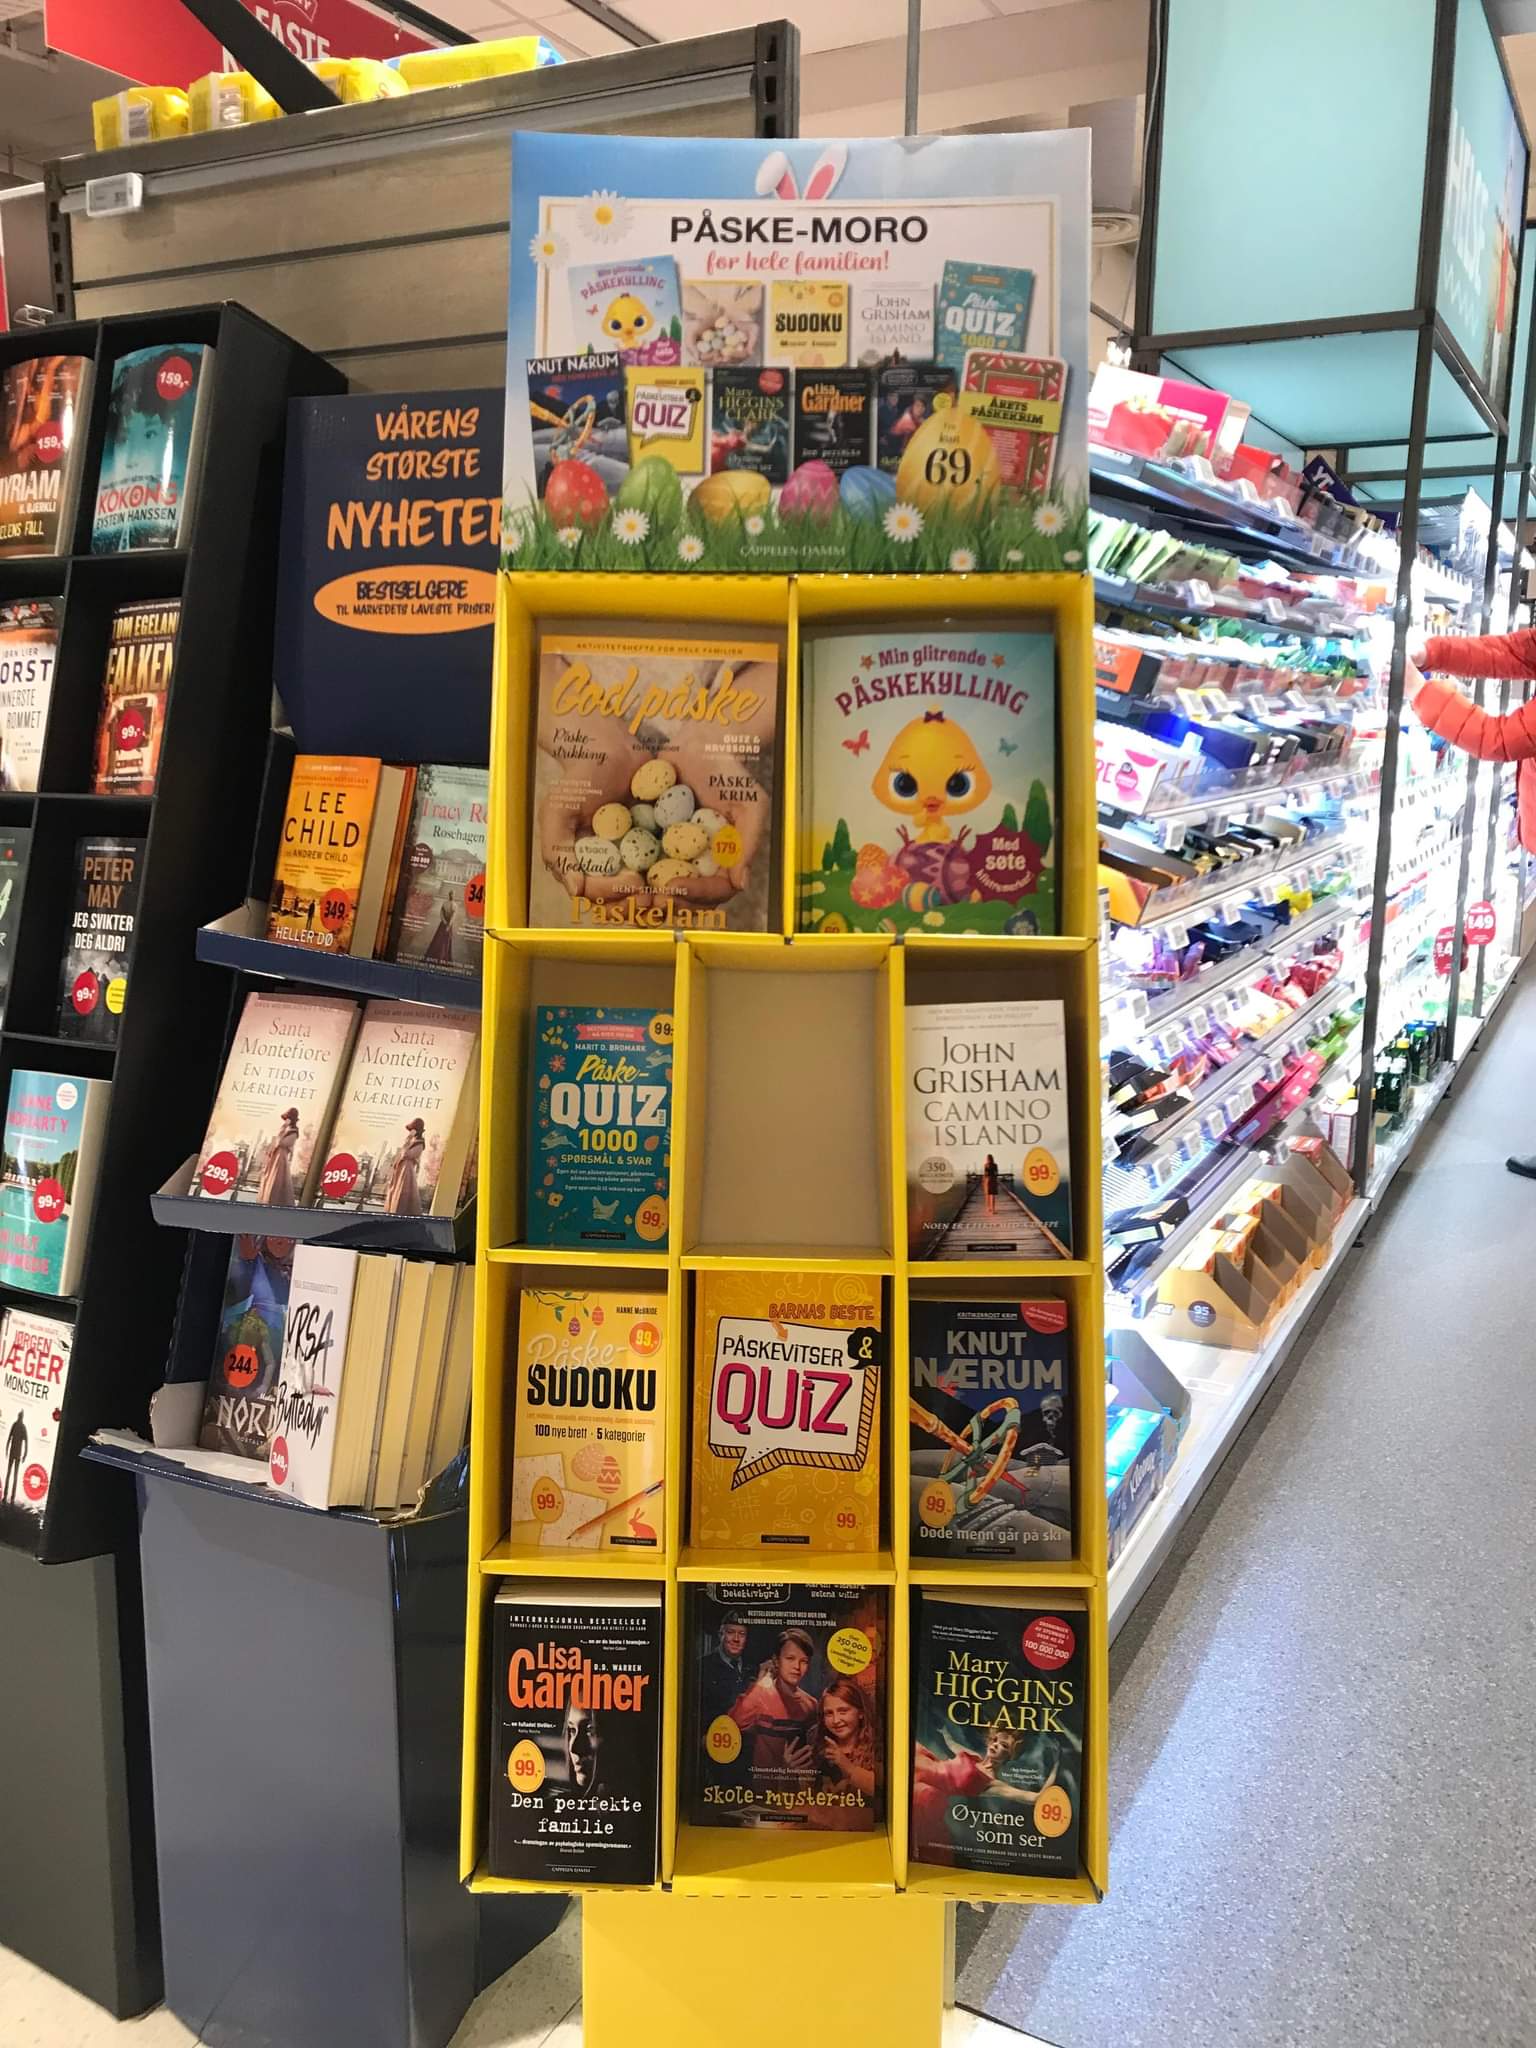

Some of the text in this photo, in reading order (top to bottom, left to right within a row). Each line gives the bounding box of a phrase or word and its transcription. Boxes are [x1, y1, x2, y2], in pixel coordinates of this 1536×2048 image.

[670, 208, 928, 244] PÅSKE-MORO
[705, 250, 889, 276] for hele familien!
[775, 313, 843, 333] SUDOKU
[861, 306, 930, 321] GRISHAM
[945, 306, 1016, 337] QUIZ
[527, 352, 619, 376] KNUT NÆRUM
[719, 396, 784, 410] HIGGINS
[802, 386, 865, 414] Gardner
[375, 403, 480, 441] VÅRENS
[634, 402, 687, 428] QUIZ
[724, 408, 778, 421] CLARK
[366, 448, 481, 481] STØRSTE
[98, 482, 177, 515] KOKONG
[127, 507, 177, 523] HANSSEN
[740, 545, 846, 557] CAPPELEN DAMM
[356, 579, 468, 600] BESTSELGERE
[336, 602, 495, 616] TIL MARKEDETS LAVESTE PRISER!
[879, 644, 987, 668] Min glitrende
[552, 661, 765, 736] God påske
[834, 670, 1030, 716] PÅSKEKYLLING
[303, 790, 347, 815] LEE
[719, 789, 758, 802] KRIM
[421, 798, 464, 825] Tracy
[284, 817, 361, 848] CHILD
[991, 837, 1020, 851] Med
[292, 848, 349, 864] ANDREW CHILD
[985, 852, 1027, 871] søte
[83, 856, 135, 883] PETER
[87, 883, 125, 909] MAY
[72, 911, 134, 932] JEG SVIKTER
[570, 895, 728, 929] Påskelam
[74, 932, 126, 952] DEG ALDRI
[275, 926, 334, 946] HELLER DØ
[269, 1017, 312, 1039] Santa
[390, 1026, 435, 1047] Santa
[240, 1036, 331, 1063] Montefiore
[360, 1045, 457, 1072] Montefiore
[575, 1043, 599, 1052] MARIT
[942, 1036, 1016, 1066] JOHN
[243, 1062, 315, 1083] EN TIDLØS
[365, 1072, 440, 1093] EN TIDLØS
[913, 1066, 1062, 1094] GRISHAM
[231, 1080, 318, 1102] KJÆRLIGHET
[352, 1090, 443, 1111] KJÆRLIGHET
[549, 1082, 668, 1129] QUIZ
[924, 1098, 1051, 1122] CAMINO
[579, 1128, 638, 1153] 1000
[935, 1123, 1042, 1147] ISLAND
[560, 1152, 653, 1166] SPØRSMÅL & SVAR
[926, 1161, 947, 1173] 350
[204, 1163, 235, 1185] 299,-
[324, 1167, 357, 1185] 299,-
[769, 1303, 875, 1321] BARNAS BESTE
[14, 1329, 52, 1354] JØRGEN
[722, 1335, 873, 1367] PÅSKEVITSER &
[946, 1330, 1028, 1356] KNUT
[913, 1356, 1063, 1391] NÆRUM
[4, 1372, 50, 1400] MONSTER
[527, 1363, 657, 1412] SUDOKU
[534, 1424, 646, 1443] 100 nye brett 5 kategorier
[956, 1529, 994, 1541] menn
[997, 1527, 1020, 1544] går
[1042, 1529, 1062, 1541] ski
[722, 1588, 780, 1599] Detektivbyrå
[509, 1615, 647, 1626] INTERNASJONAL BESTSELGER
[537, 1641, 582, 1671] Lisa
[851, 1641, 868, 1652] 000
[1024, 1639, 1039, 1651] 100
[613, 1664, 642, 1672] WARREN
[948, 1650, 1009, 1682] Mary
[508, 1648, 650, 1712] Gardner
[933, 1671, 1074, 1706] HIGGINS
[947, 1700, 1065, 1733] CLARK
[511, 1792, 642, 1813] Den perfekte
[703, 1785, 866, 1810] Skole-mysteriet
[537, 1817, 615, 1835] familie
[952, 1803, 1025, 1828] Øynene
[976, 1830, 1046, 1848] som ser
